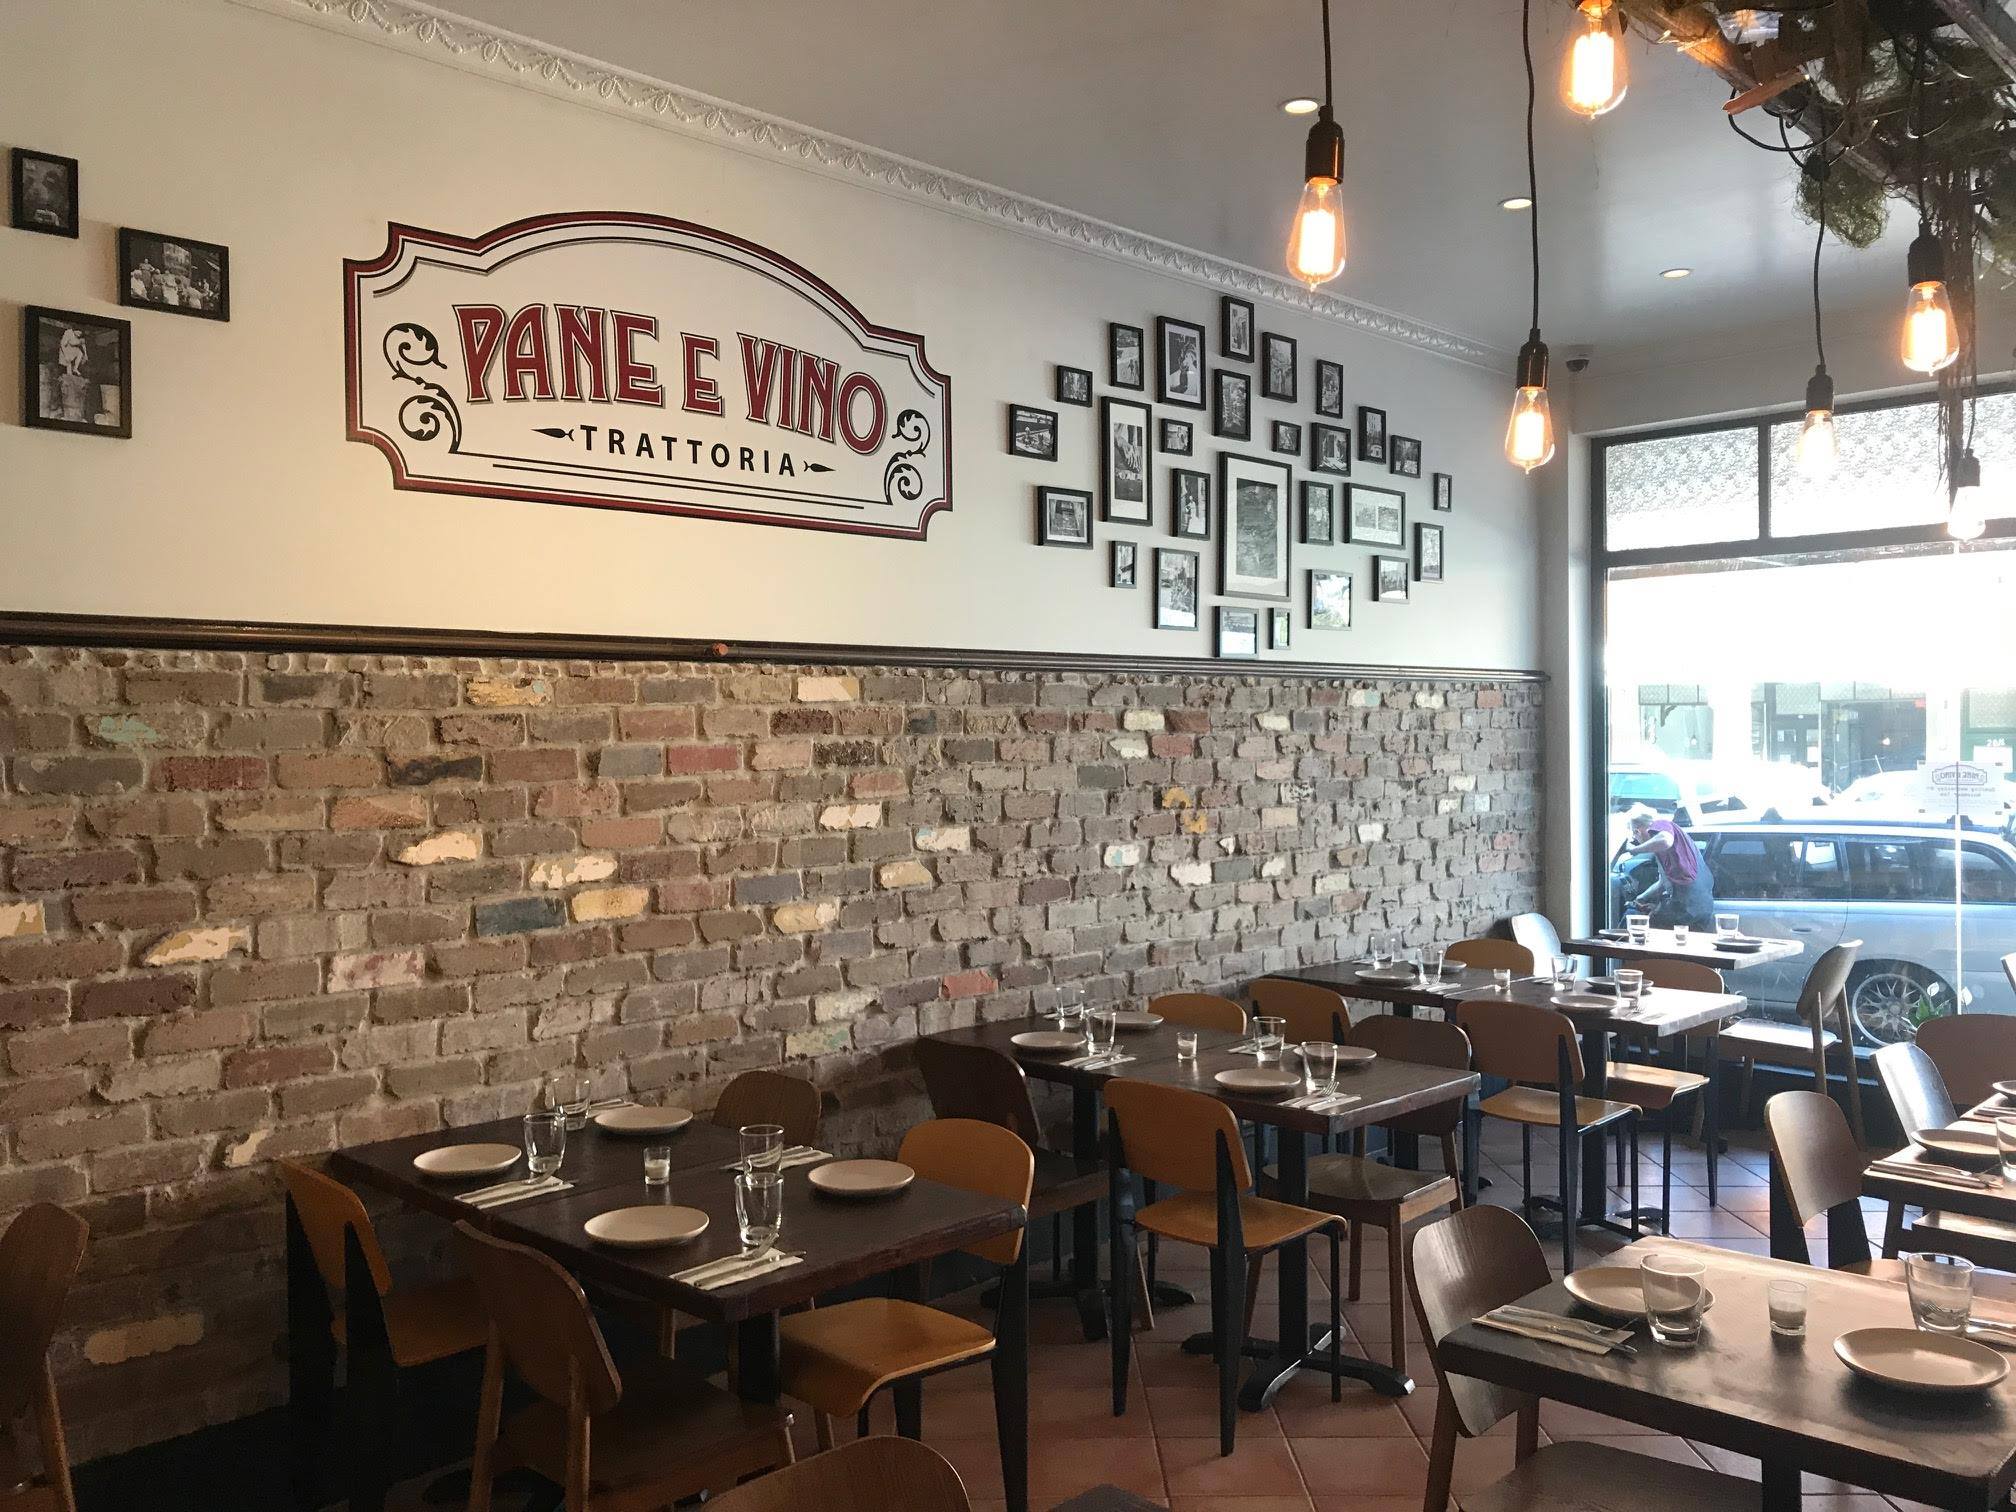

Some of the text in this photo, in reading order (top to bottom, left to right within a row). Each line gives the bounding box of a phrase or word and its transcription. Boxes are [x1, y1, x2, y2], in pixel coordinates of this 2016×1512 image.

[452, 303, 890, 456] PANE E VINO
[581, 424, 796, 477] TRATTORIA
